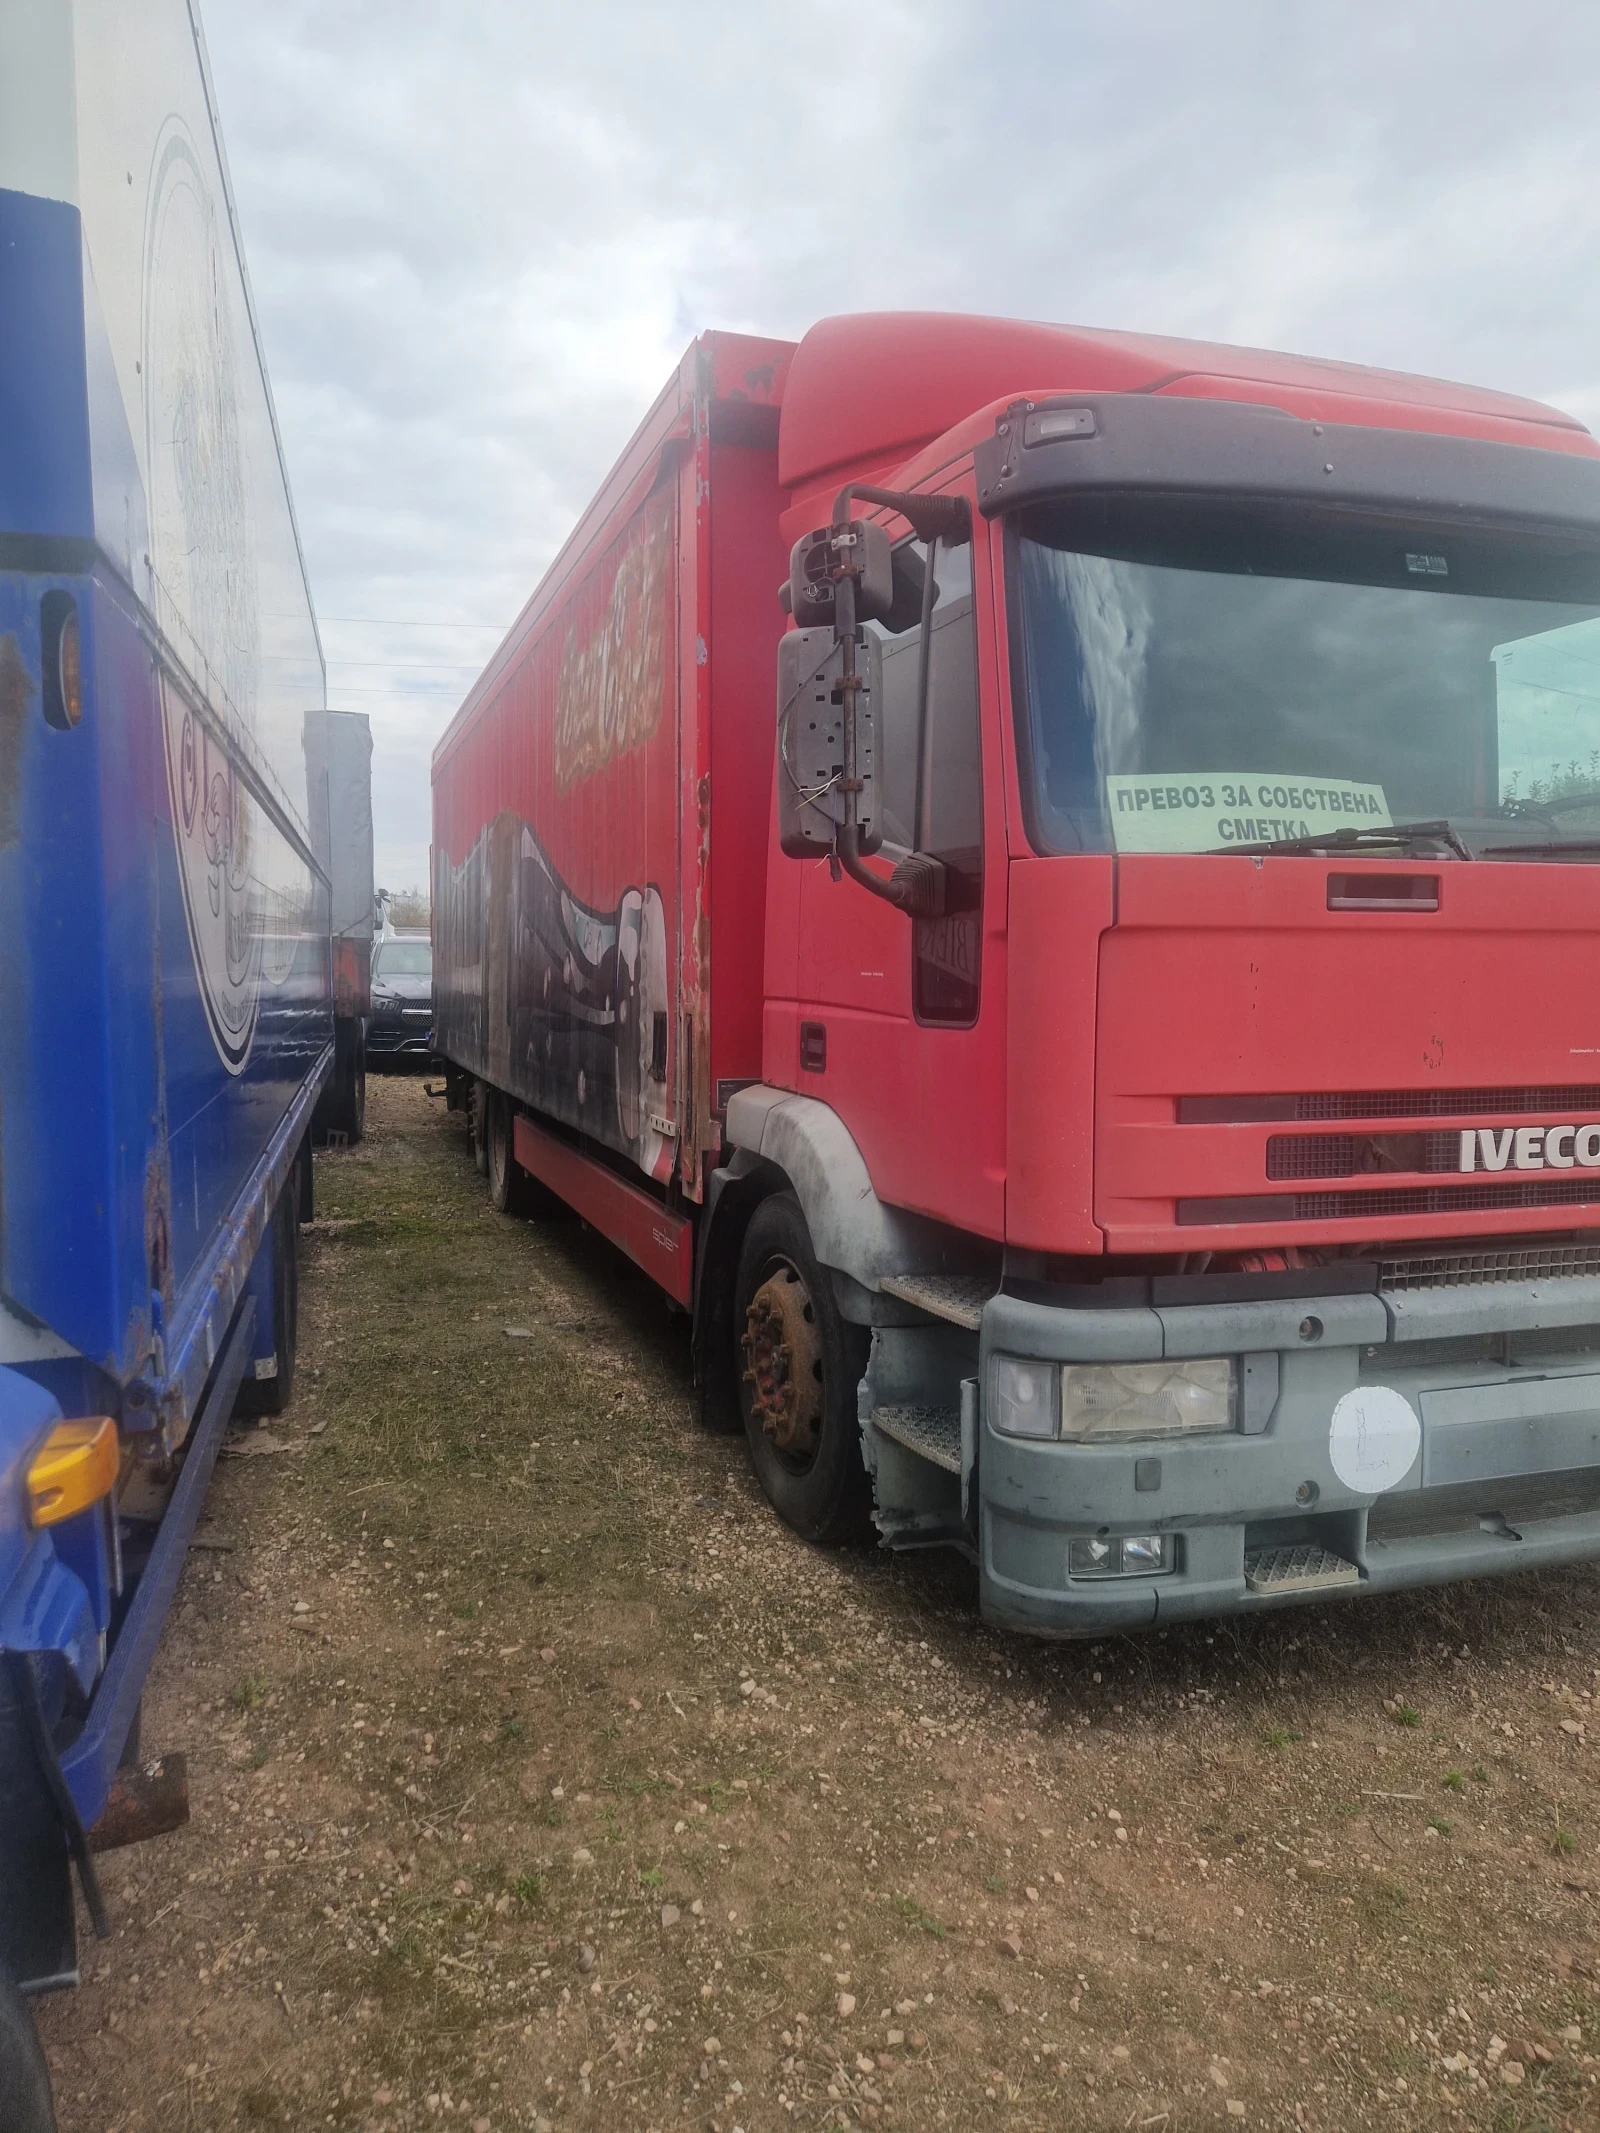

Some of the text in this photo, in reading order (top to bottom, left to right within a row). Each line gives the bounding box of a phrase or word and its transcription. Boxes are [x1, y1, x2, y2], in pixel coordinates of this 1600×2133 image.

[1116, 785, 1383, 815] ПРЕВОЗ ЗА СОБСТВЕНА
[1217, 818, 1311, 841] СМЕТКА
[1460, 1124, 1600, 1173] IVECO
